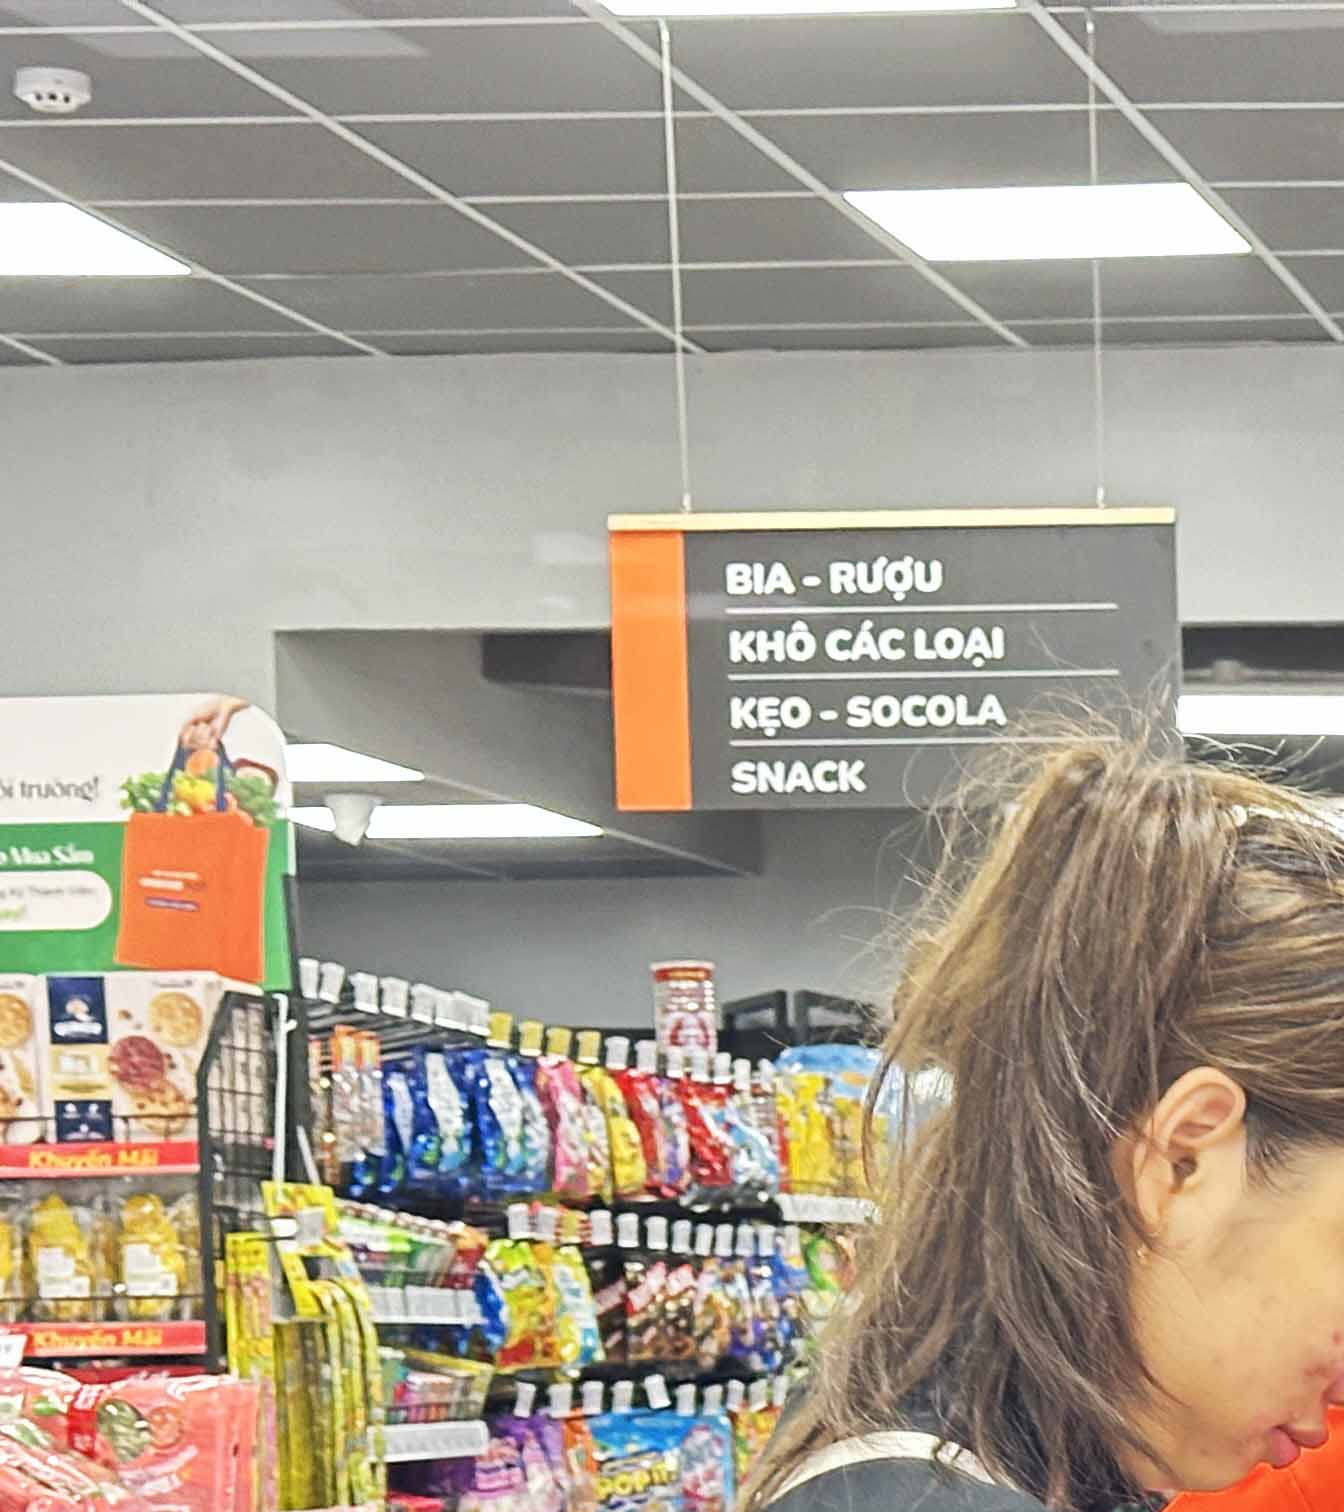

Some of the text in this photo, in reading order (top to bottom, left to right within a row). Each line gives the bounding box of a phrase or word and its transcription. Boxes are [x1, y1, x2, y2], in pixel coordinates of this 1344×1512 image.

[726, 561, 795, 595] BIA
[830, 556, 943, 601] RƯỢU
[729, 621, 1005, 667] KHÔ CÁC LOẠI
[730, 697, 812, 737] KẸO
[846, 694, 1006, 728] SOCOLA
[731, 761, 867, 793] SNACK
